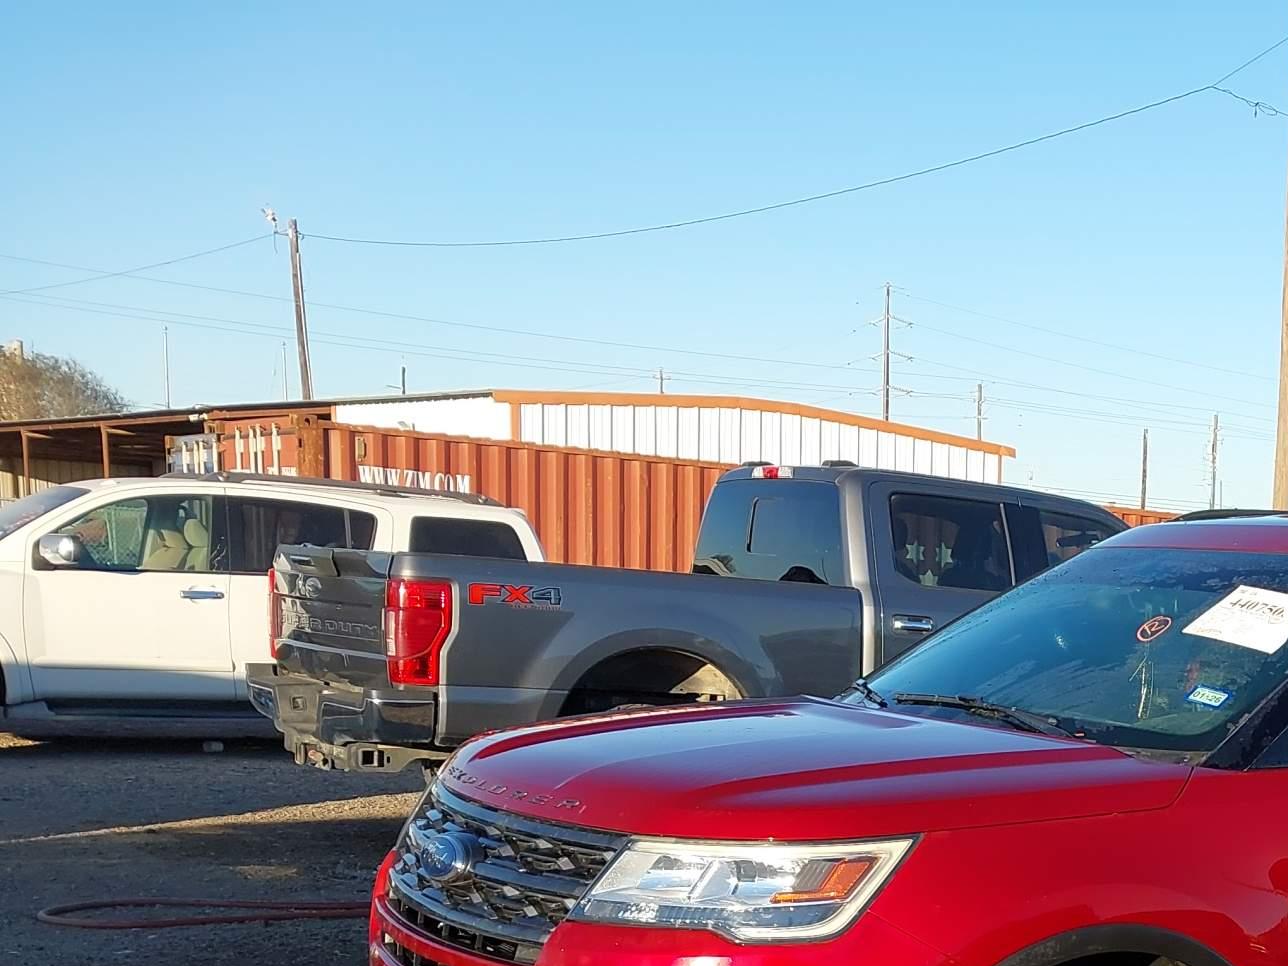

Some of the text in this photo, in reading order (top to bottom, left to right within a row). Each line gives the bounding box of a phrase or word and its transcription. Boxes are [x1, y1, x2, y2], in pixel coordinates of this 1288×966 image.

[358, 465, 471, 494] WWWZIM.COM
[467, 583, 562, 606] FX4
[448, 766, 587, 814] EXPLORER
